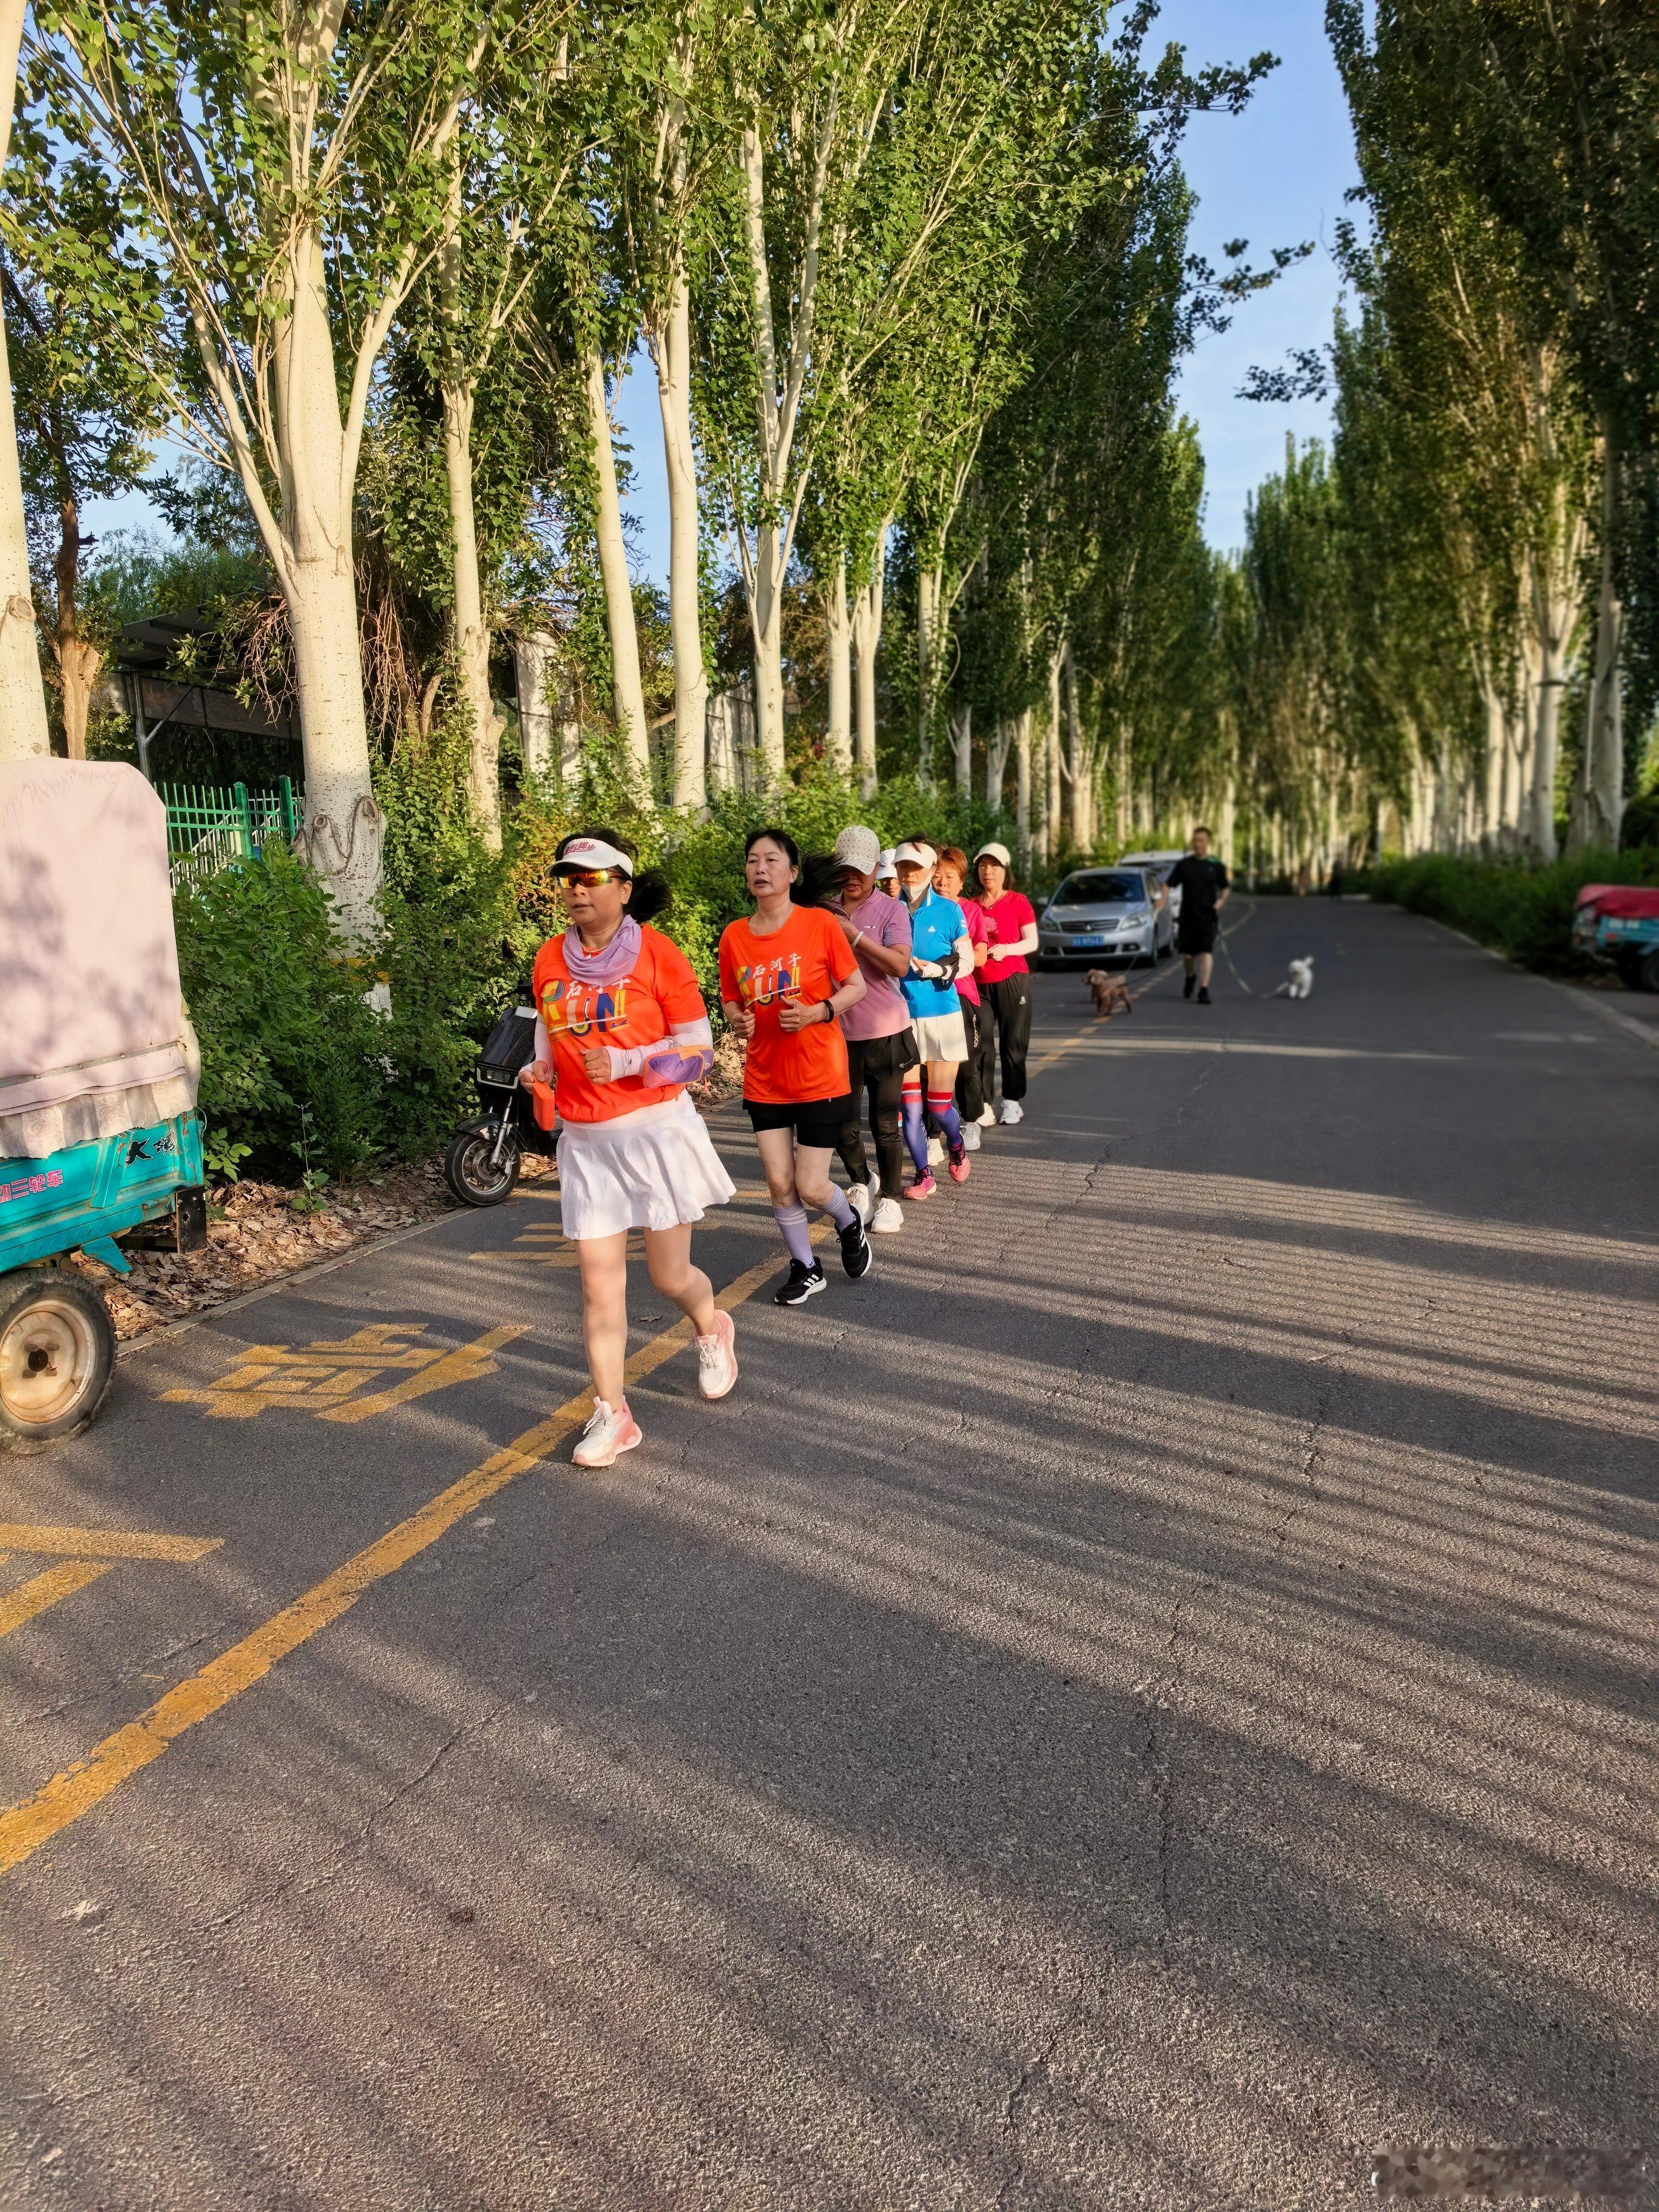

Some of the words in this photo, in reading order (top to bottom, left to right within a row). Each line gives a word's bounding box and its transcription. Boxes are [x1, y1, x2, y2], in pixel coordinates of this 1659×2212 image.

[737, 966, 802, 1006] RUN
[753, 953, 801, 979] 石河子
[542, 980, 630, 1037] RUN
